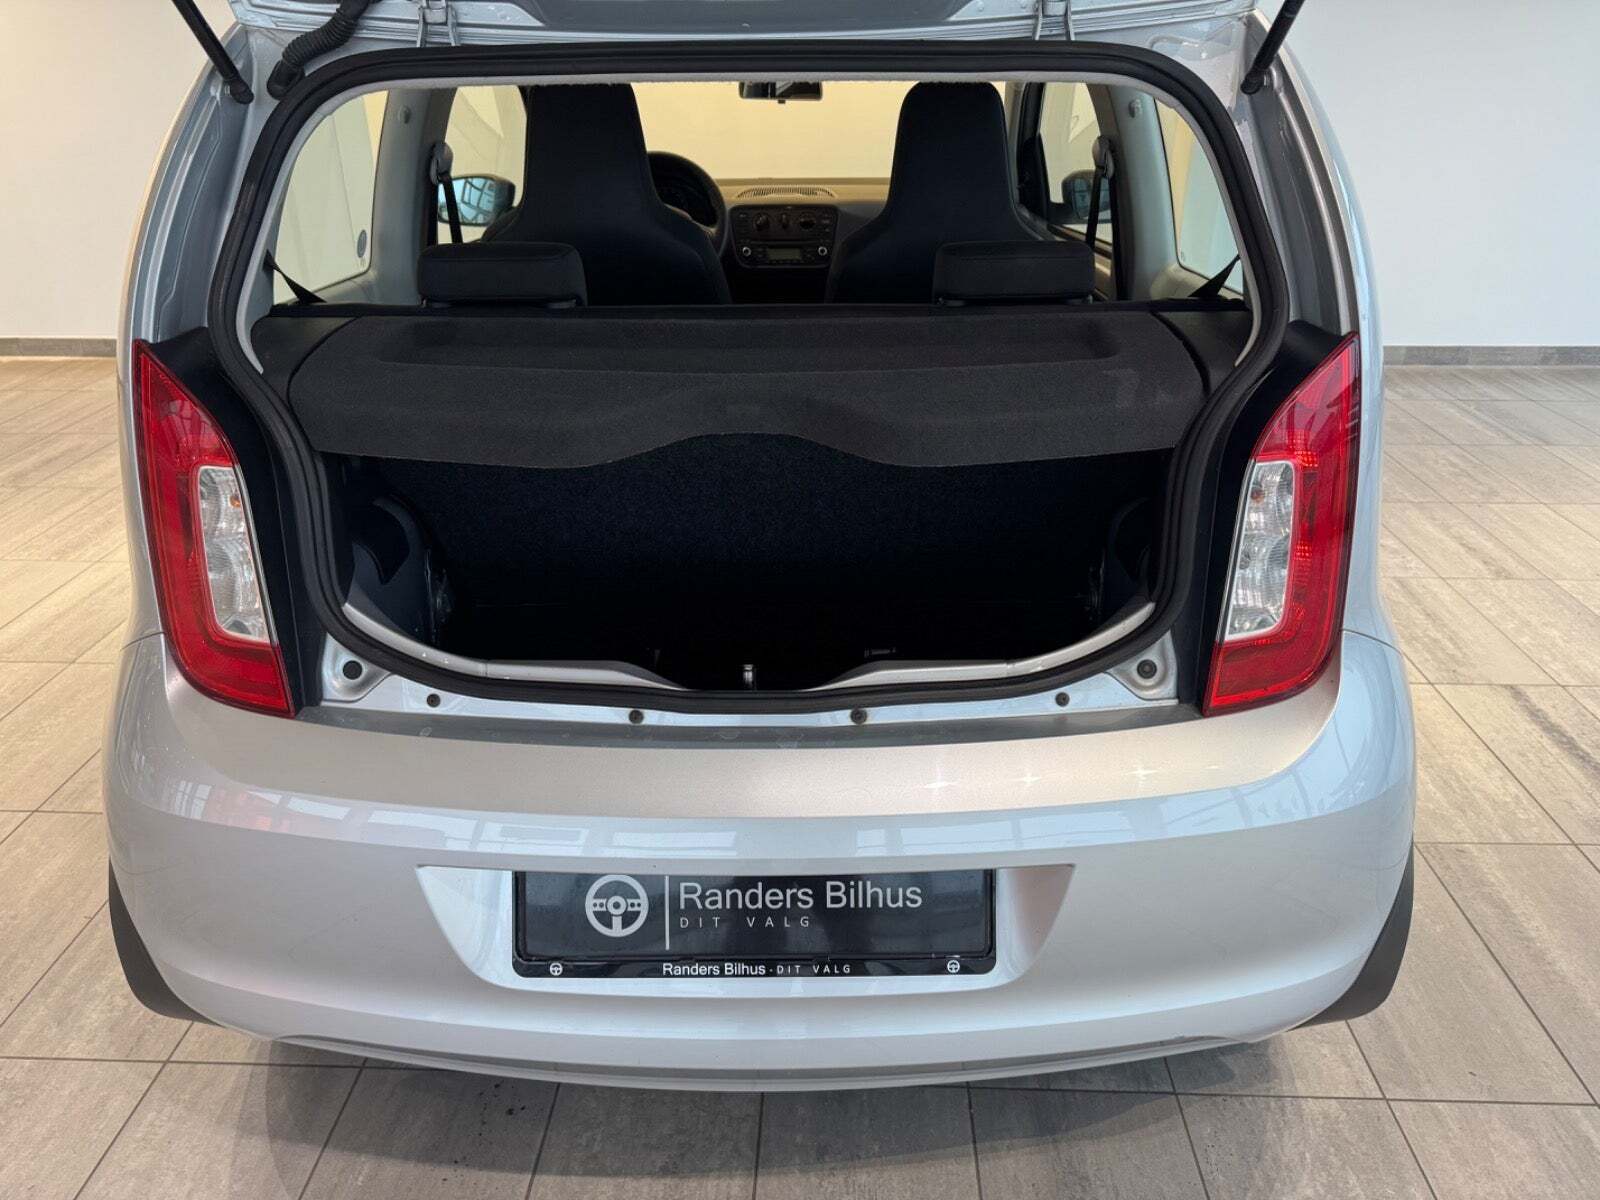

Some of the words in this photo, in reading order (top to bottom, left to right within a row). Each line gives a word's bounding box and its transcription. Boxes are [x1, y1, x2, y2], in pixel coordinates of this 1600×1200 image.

[679, 881, 814, 910] Randers
[826, 880, 923, 909] Bilhus
[679, 916, 721, 929] DIT
[746, 916, 811, 928] VALG
[662, 962, 720, 976] Randers
[724, 962, 766, 976] Bilhus
[776, 964, 801, 975] DIT
[812, 963, 851, 974] VALG
